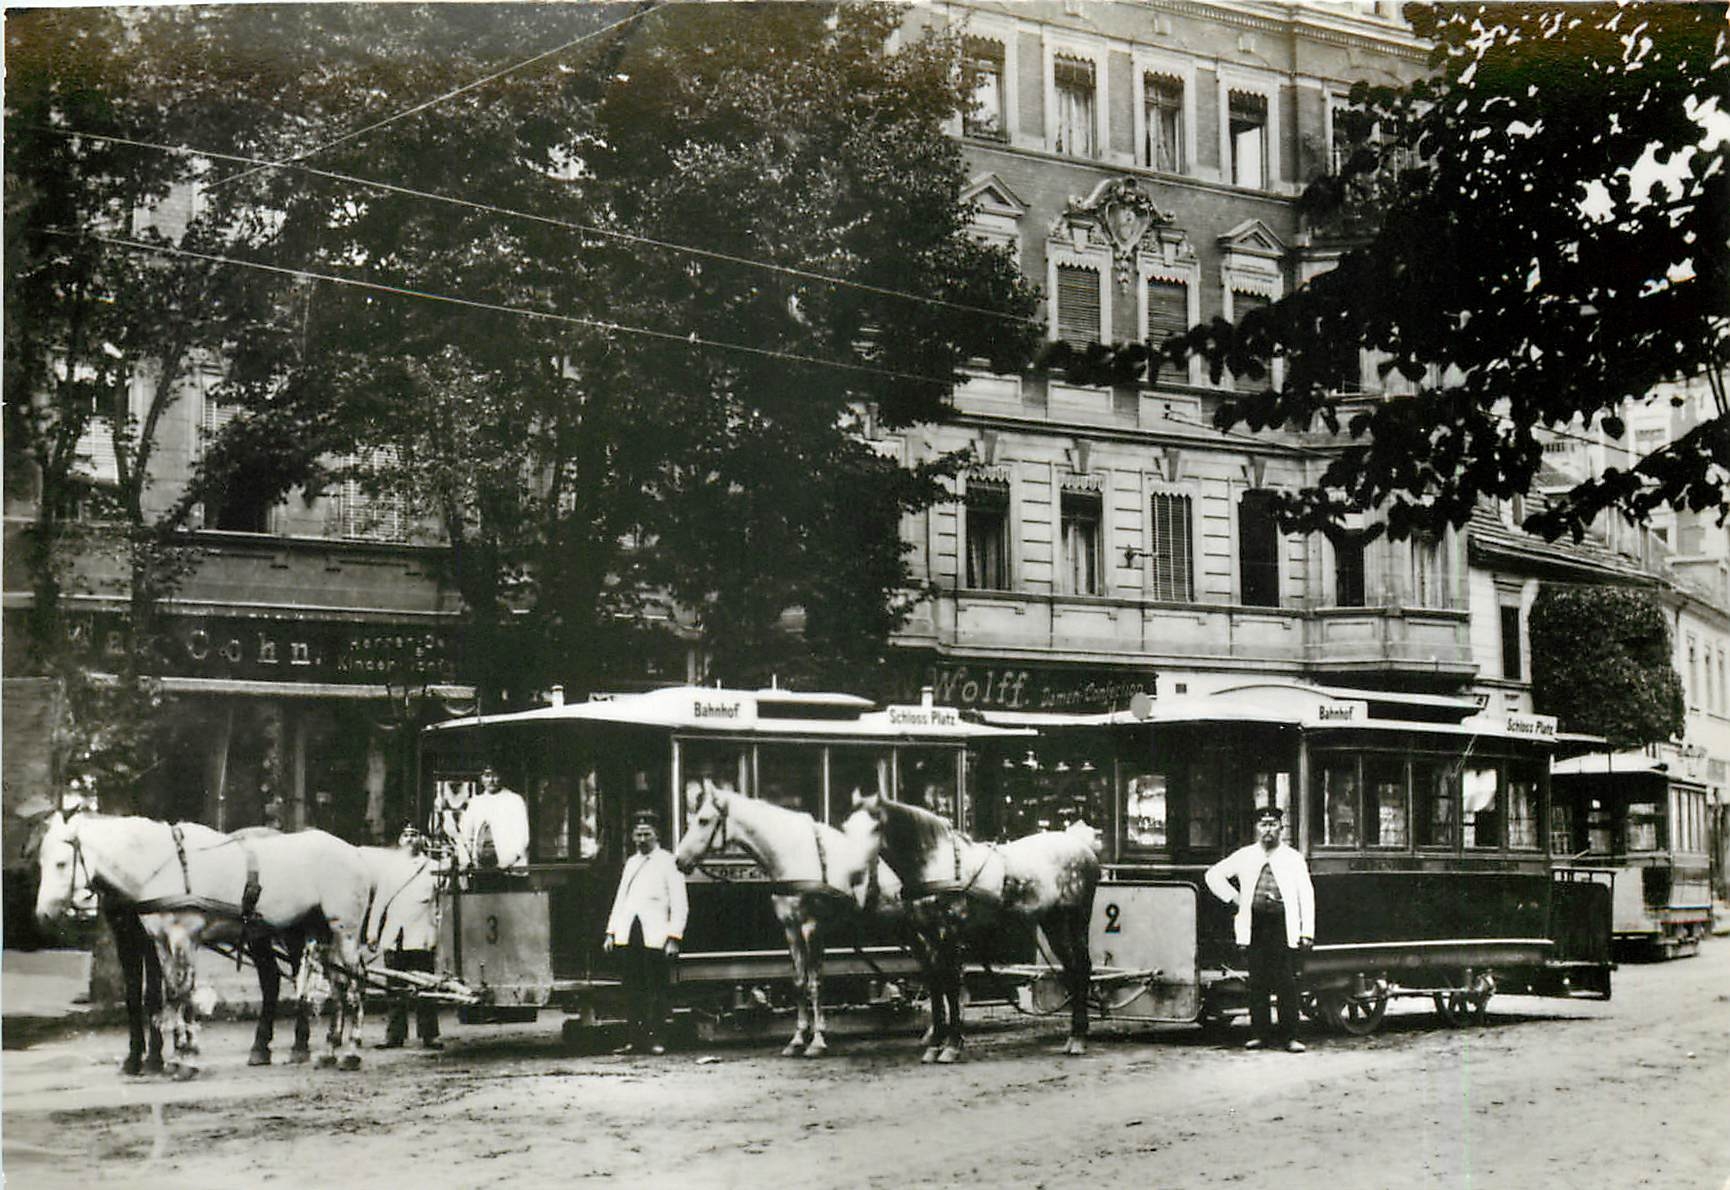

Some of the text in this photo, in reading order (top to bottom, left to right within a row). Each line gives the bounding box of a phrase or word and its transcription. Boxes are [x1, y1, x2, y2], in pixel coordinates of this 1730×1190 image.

[694, 701, 740, 718] Bahnhof
[889, 708, 955, 726] Schloss Platz
[1319, 705, 1354, 720] Bahnhof
[1506, 717, 1534, 734] Schloss
[1104, 903, 1121, 933] 2
[486, 914, 498, 945] 3
